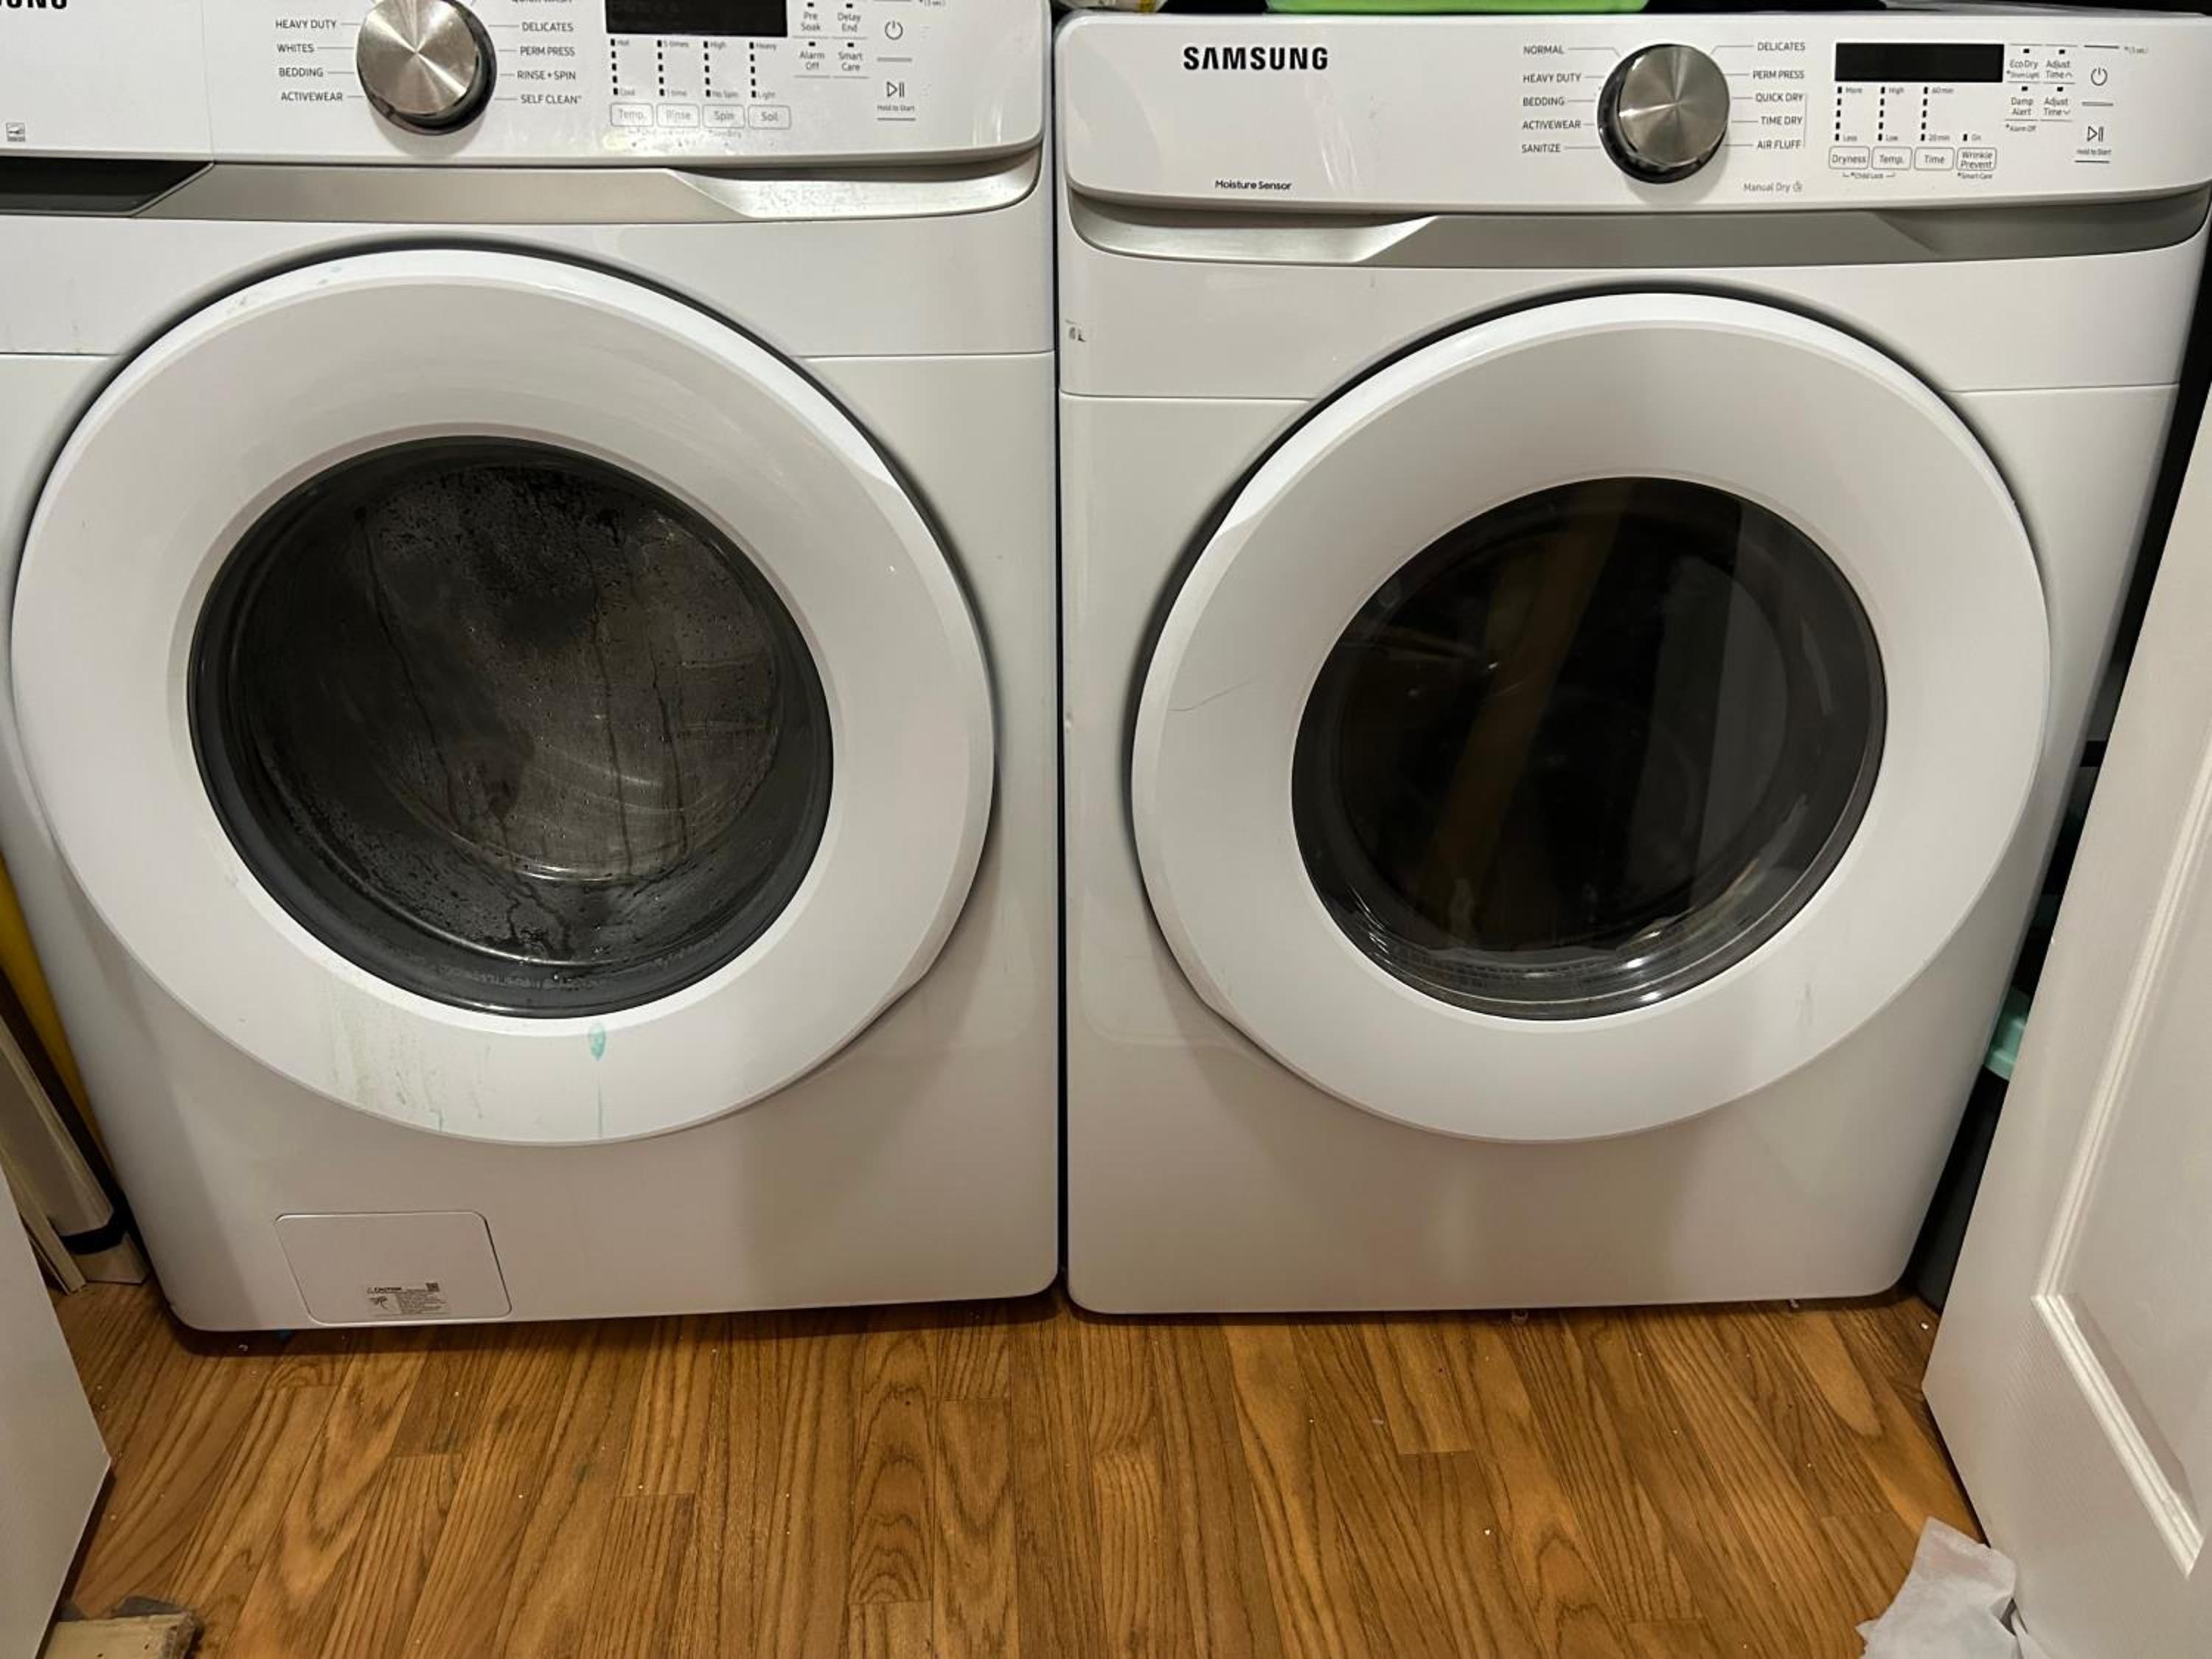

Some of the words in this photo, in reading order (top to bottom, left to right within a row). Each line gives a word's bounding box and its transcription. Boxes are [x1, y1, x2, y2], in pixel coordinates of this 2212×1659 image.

[804, 12, 818, 20] Pre
[838, 13, 861, 22] Delay
[275, 20, 307, 29] HEAVY
[310, 20, 337, 29] DUTY
[521, 21, 574, 32] DELICATES
[801, 23, 821, 32] Soak
[842, 24, 858, 32] End
[276, 44, 315, 53] WHITES
[1523, 45, 1565, 55] NORMAL
[1757, 42, 1806, 51] DELICATES
[520, 46, 546, 56] PERM
[547, 46, 575, 57] PRESS
[799, 51, 825, 60] Alarm
[838, 52, 863, 60] Smart
[1183, 46, 1328, 70] SAMSUNG
[805, 61, 819, 70] Off
[841, 63, 860, 72] Care
[2009, 60, 2023, 69] Eco
[2024, 60, 2039, 70] Dry
[2045, 60, 2070, 69] Adjust
[279, 67, 324, 77] BEDDING
[517, 71, 546, 80] RINSE
[554, 71, 576, 80] SPIN
[1753, 70, 1776, 80] PERM
[1778, 70, 1805, 80] PRESS
[2045, 71, 2065, 79] Time
[1523, 73, 1554, 83] HEAVY
[1557, 73, 1582, 83] DUTY
[281, 92, 343, 101] ACTIVEWEAR
[521, 94, 543, 104] SELF
[1756, 93, 1784, 102] QUICK
[1785, 93, 1804, 102] DRY
[1523, 97, 1565, 106] BEDDING
[2011, 97, 2034, 106] Damp
[2044, 97, 2069, 107] Adjust
[667, 110, 692, 120] Rinse
[2012, 107, 2032, 116] Alert
[2043, 107, 2062, 116] Time
[713, 111, 735, 122] Spin
[761, 111, 779, 122] Soil
[1761, 116, 1782, 125] TIME
[1784, 116, 1803, 125] DRY
[1522, 120, 1581, 130] ACTIVEWEAR
[1521, 144, 1561, 153] SANITIZE
[1757, 140, 1773, 149] AIR
[1775, 140, 1801, 149] FLUFF
[1832, 153, 1867, 165] Dryness
[1924, 154, 1945, 164] Time
[1961, 151, 1993, 159] Wrinkle
[1961, 160, 1992, 170] Prevent
[1214, 179, 1257, 189] Moisture
[1258, 180, 1293, 190] Sensor
[1744, 181, 1774, 192] Manual
[1775, 182, 1791, 193] Dry
